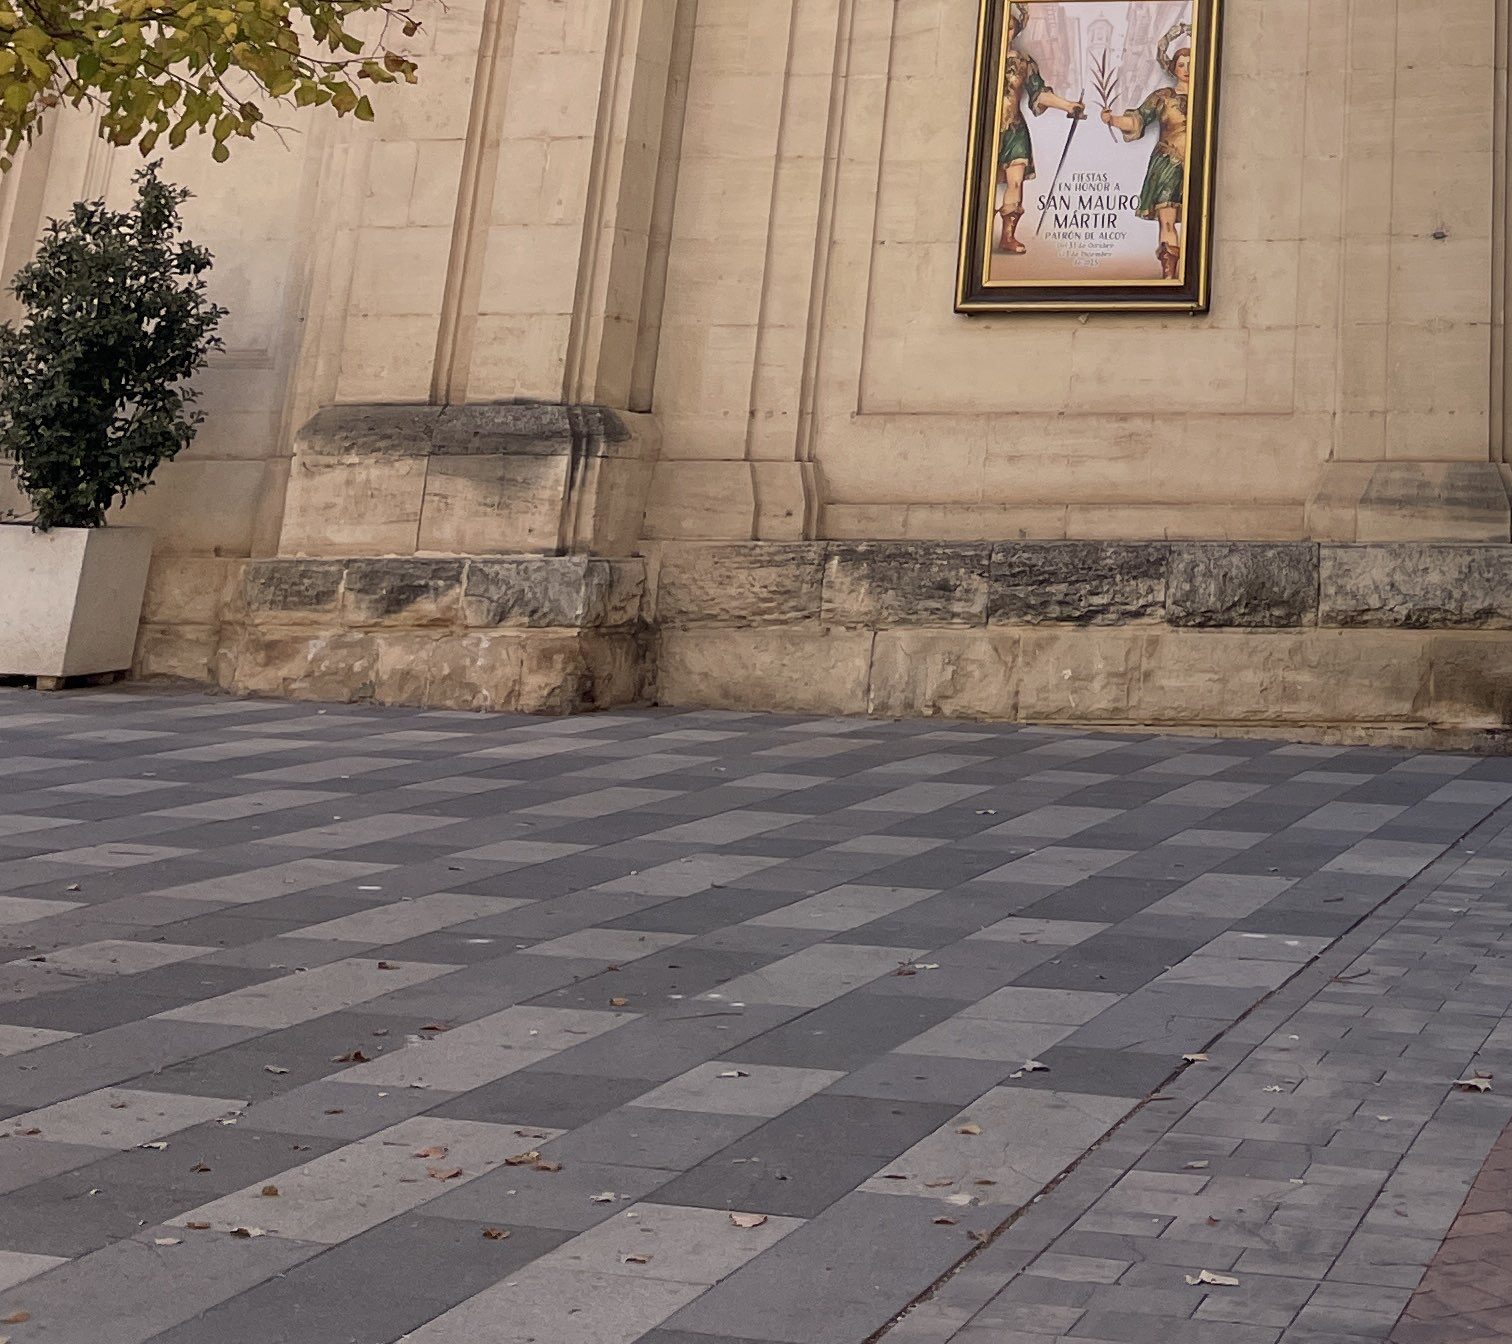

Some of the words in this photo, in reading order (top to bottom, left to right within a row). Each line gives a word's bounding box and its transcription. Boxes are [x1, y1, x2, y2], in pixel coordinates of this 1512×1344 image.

[1072, 173, 1108, 182] FIESTAS
[1058, 182, 1072, 191] EN
[1074, 182, 1111, 192] HONOR
[1113, 182, 1121, 191] A
[1037, 194, 1071, 211] SAN
[1077, 194, 1140, 211] MAURO
[1053, 209, 1118, 229] MÁRTIR
[1044, 231, 1081, 240] PATRÓN
[1084, 231, 1094, 240] DE
[1099, 231, 1128, 240] ALCOY
